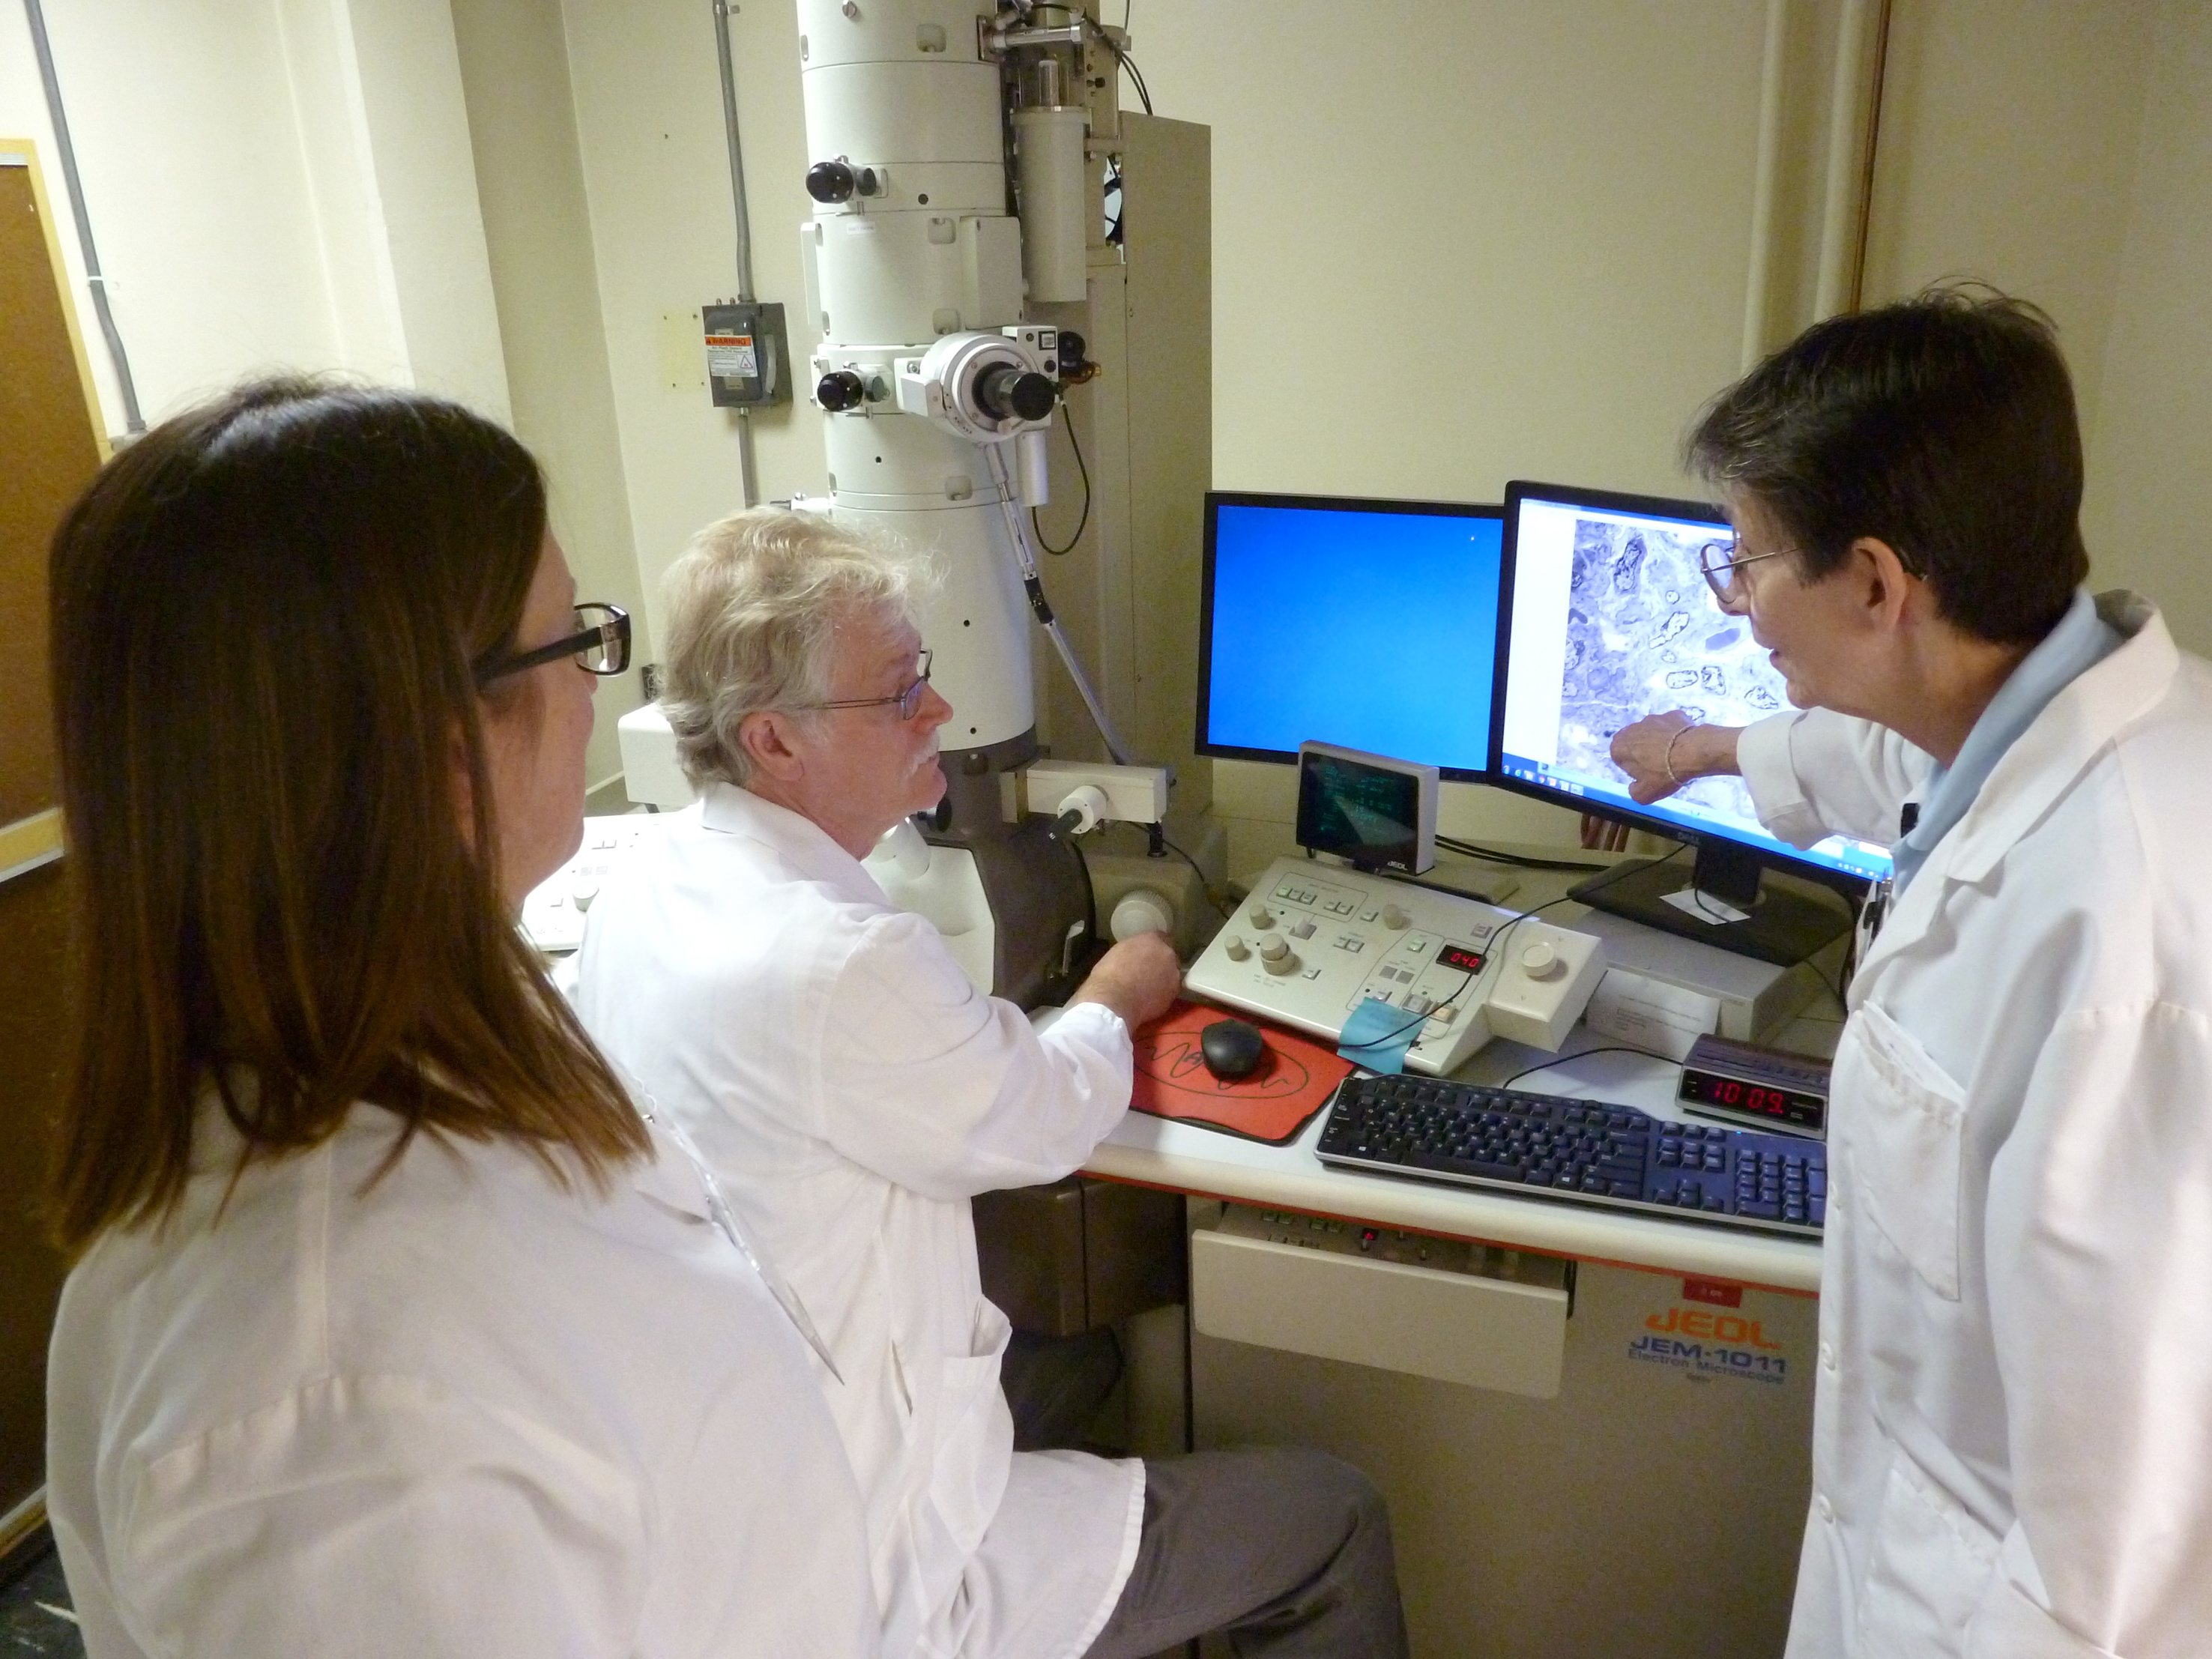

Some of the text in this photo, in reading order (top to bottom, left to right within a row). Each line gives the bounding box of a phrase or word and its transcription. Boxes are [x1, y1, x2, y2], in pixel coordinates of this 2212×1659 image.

[1387, 860, 1409, 871] JEOL
[1451, 952, 1480, 968] 040
[1645, 1308, 1782, 1350] JEOL
[1628, 1347, 1690, 1368] Electron
[1696, 1359, 1786, 1385] Microscope
